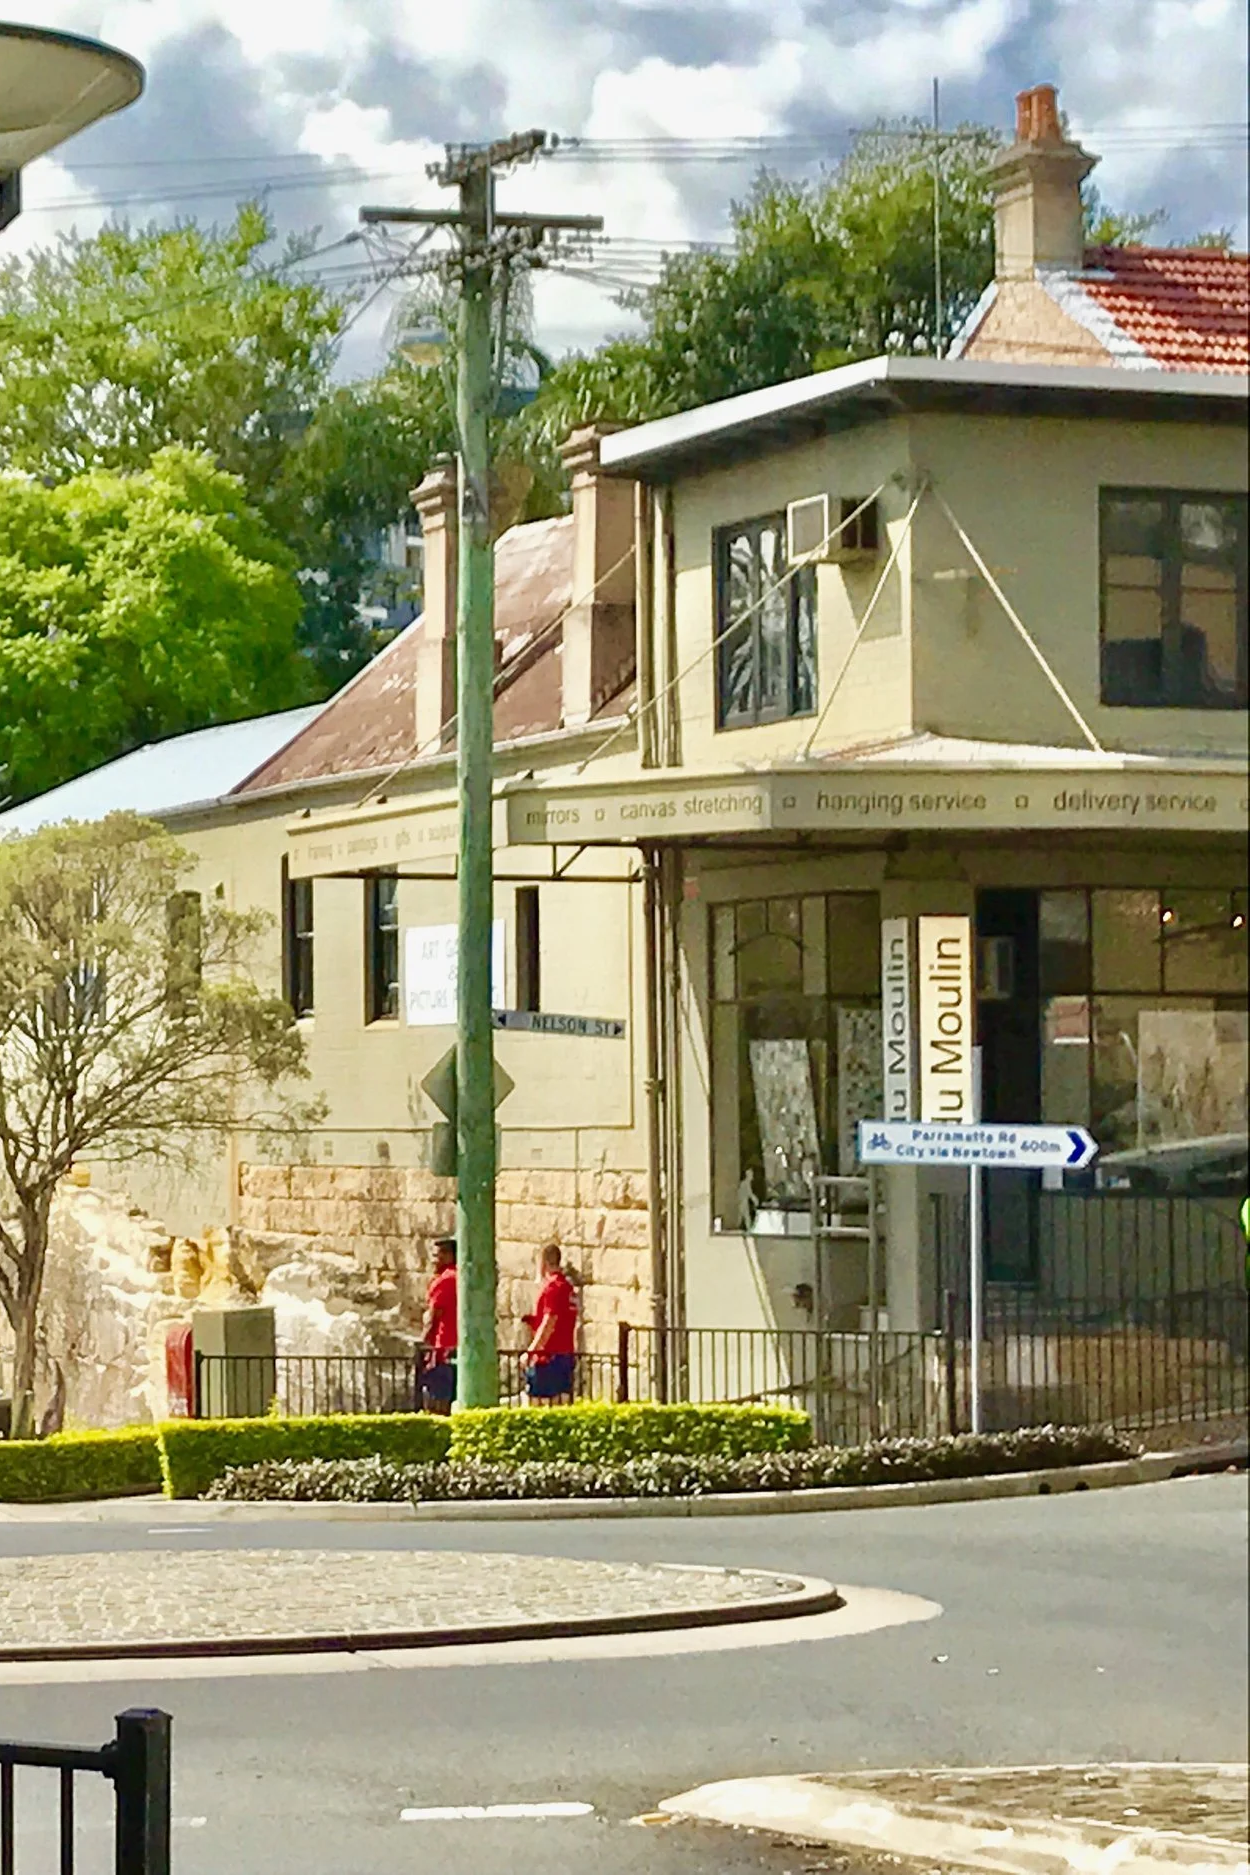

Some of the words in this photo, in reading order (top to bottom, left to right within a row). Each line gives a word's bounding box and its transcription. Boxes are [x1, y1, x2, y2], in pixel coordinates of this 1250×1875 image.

[526, 807, 581, 825] mirrors
[620, 800, 678, 820] canvas
[683, 793, 763, 816] stretching
[817, 791, 903, 815] hanging
[909, 792, 987, 811] service
[1053, 791, 1140, 815] delivery
[1148, 792, 1217, 812] service
[886, 937, 906, 1075] Moulin
[928, 936, 964, 1075] Moulin
[531, 1014, 586, 1034] NELSON
[594, 1019, 610, 1035] ST
[912, 1129, 992, 1144] Parramatta
[998, 1132, 1017, 1144] Rd
[1020, 1140, 1061, 1153] 600m
[896, 1144, 924, 1159] City
[929, 1145, 948, 1158] via
[952, 1145, 1016, 1159] Newtown
